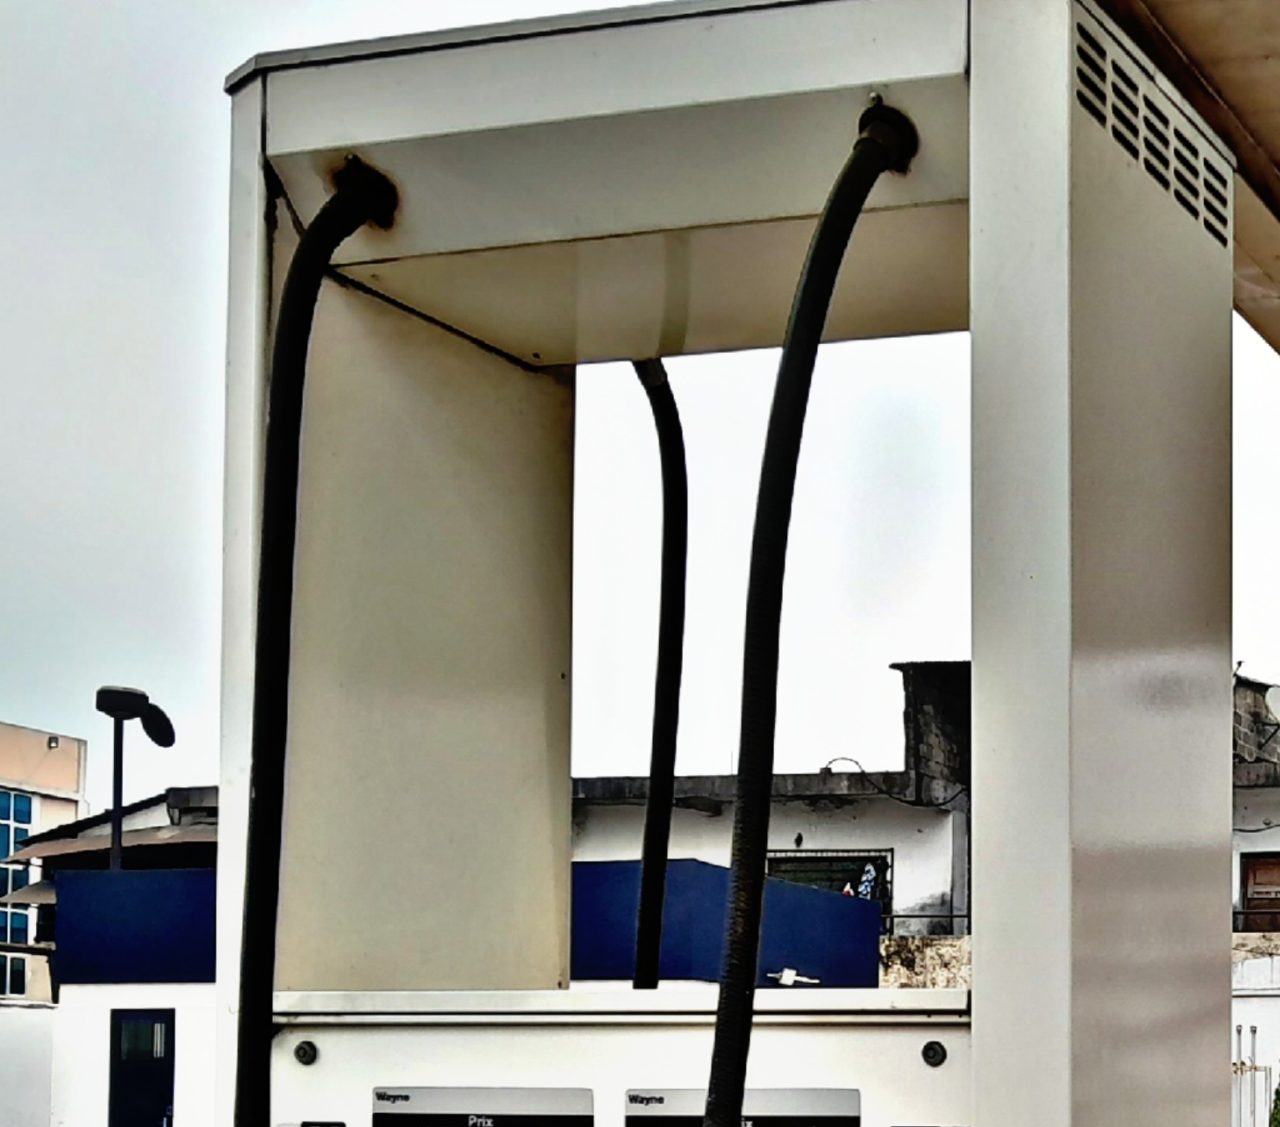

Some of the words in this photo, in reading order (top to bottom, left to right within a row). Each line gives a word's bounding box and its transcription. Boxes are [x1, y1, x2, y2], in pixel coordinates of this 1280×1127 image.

[375, 1091, 410, 1104] Wayne
[628, 1094, 665, 1106] Wayne
[468, 1115, 494, 1127] Prix
